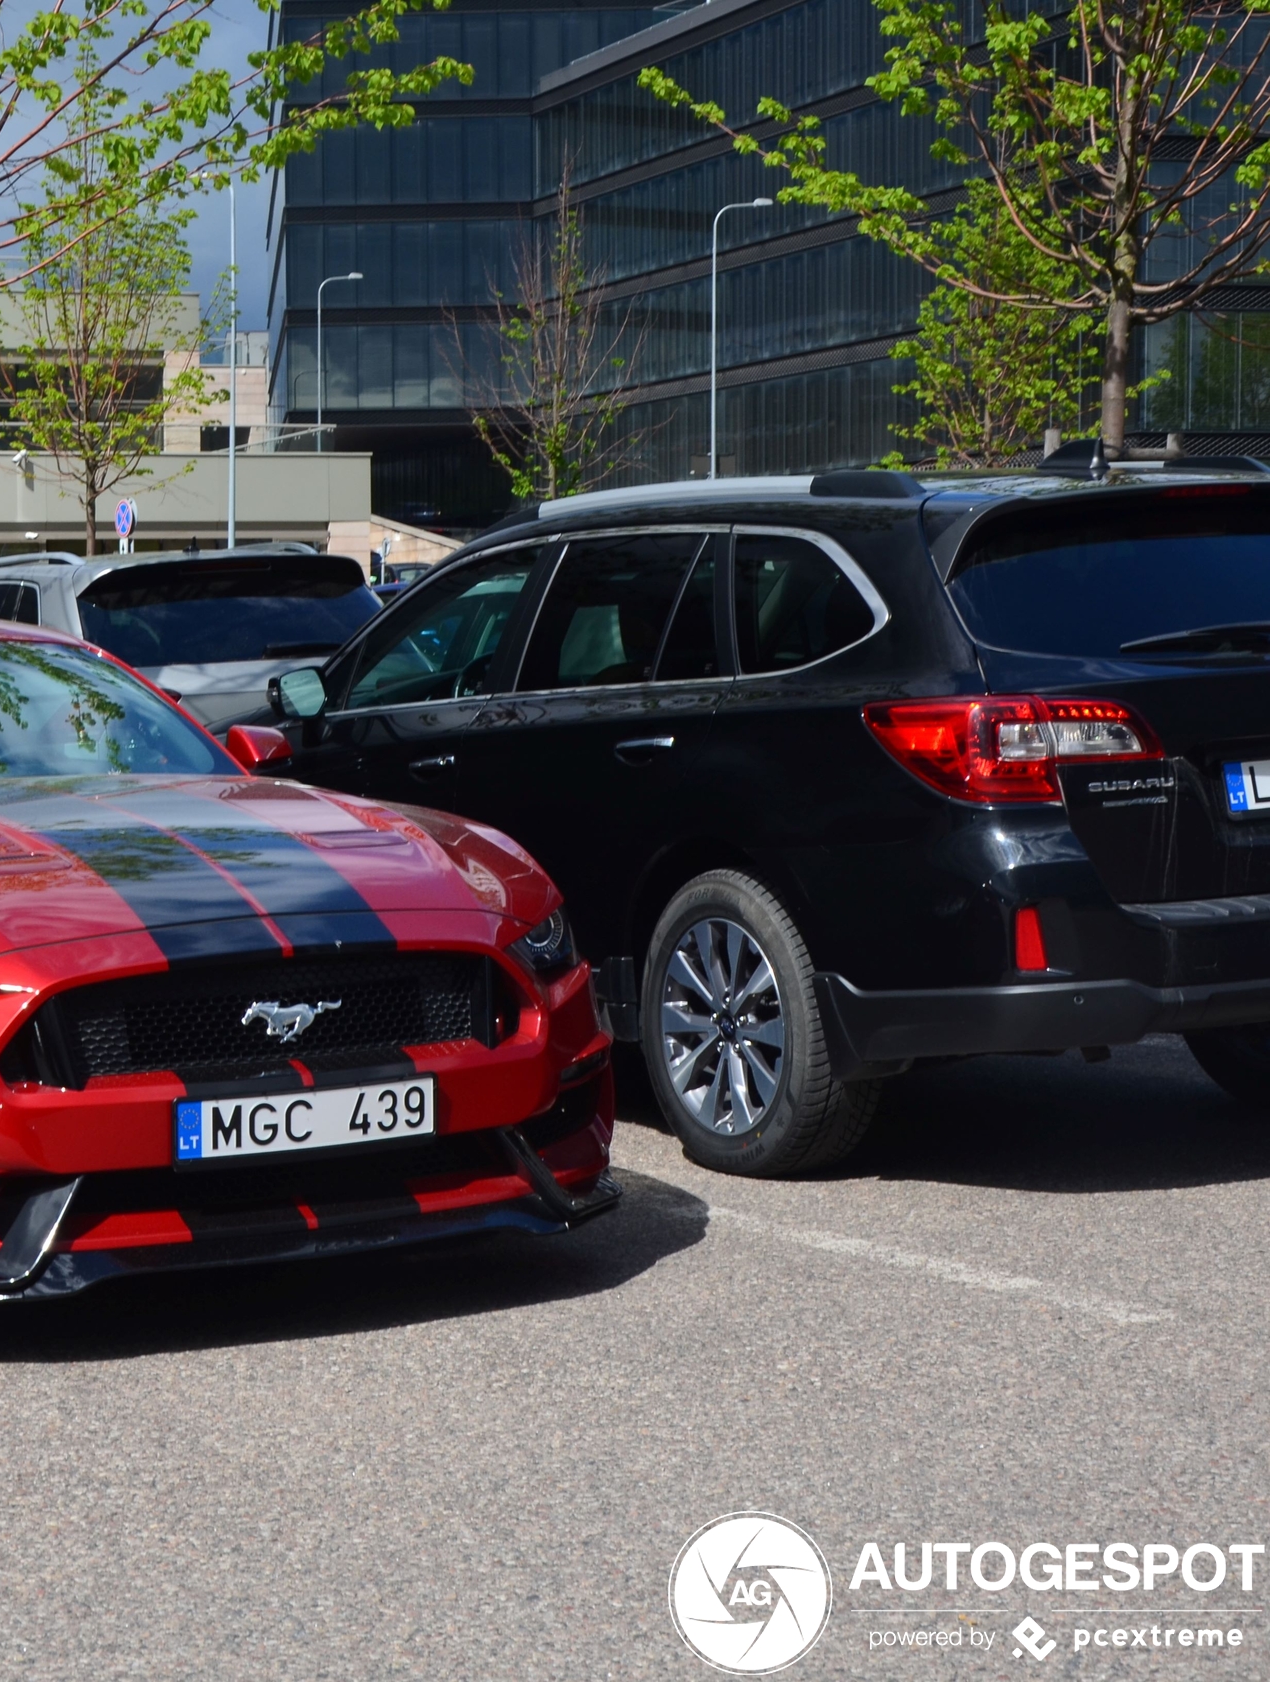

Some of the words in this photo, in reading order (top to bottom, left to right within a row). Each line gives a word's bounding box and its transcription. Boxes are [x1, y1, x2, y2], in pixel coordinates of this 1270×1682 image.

[1088, 777, 1174, 792] SUBARU
[1229, 792, 1245, 804] LT
[180, 1136, 199, 1150] LT
[212, 1099, 313, 1150] MGC
[349, 1086, 426, 1135] 439
